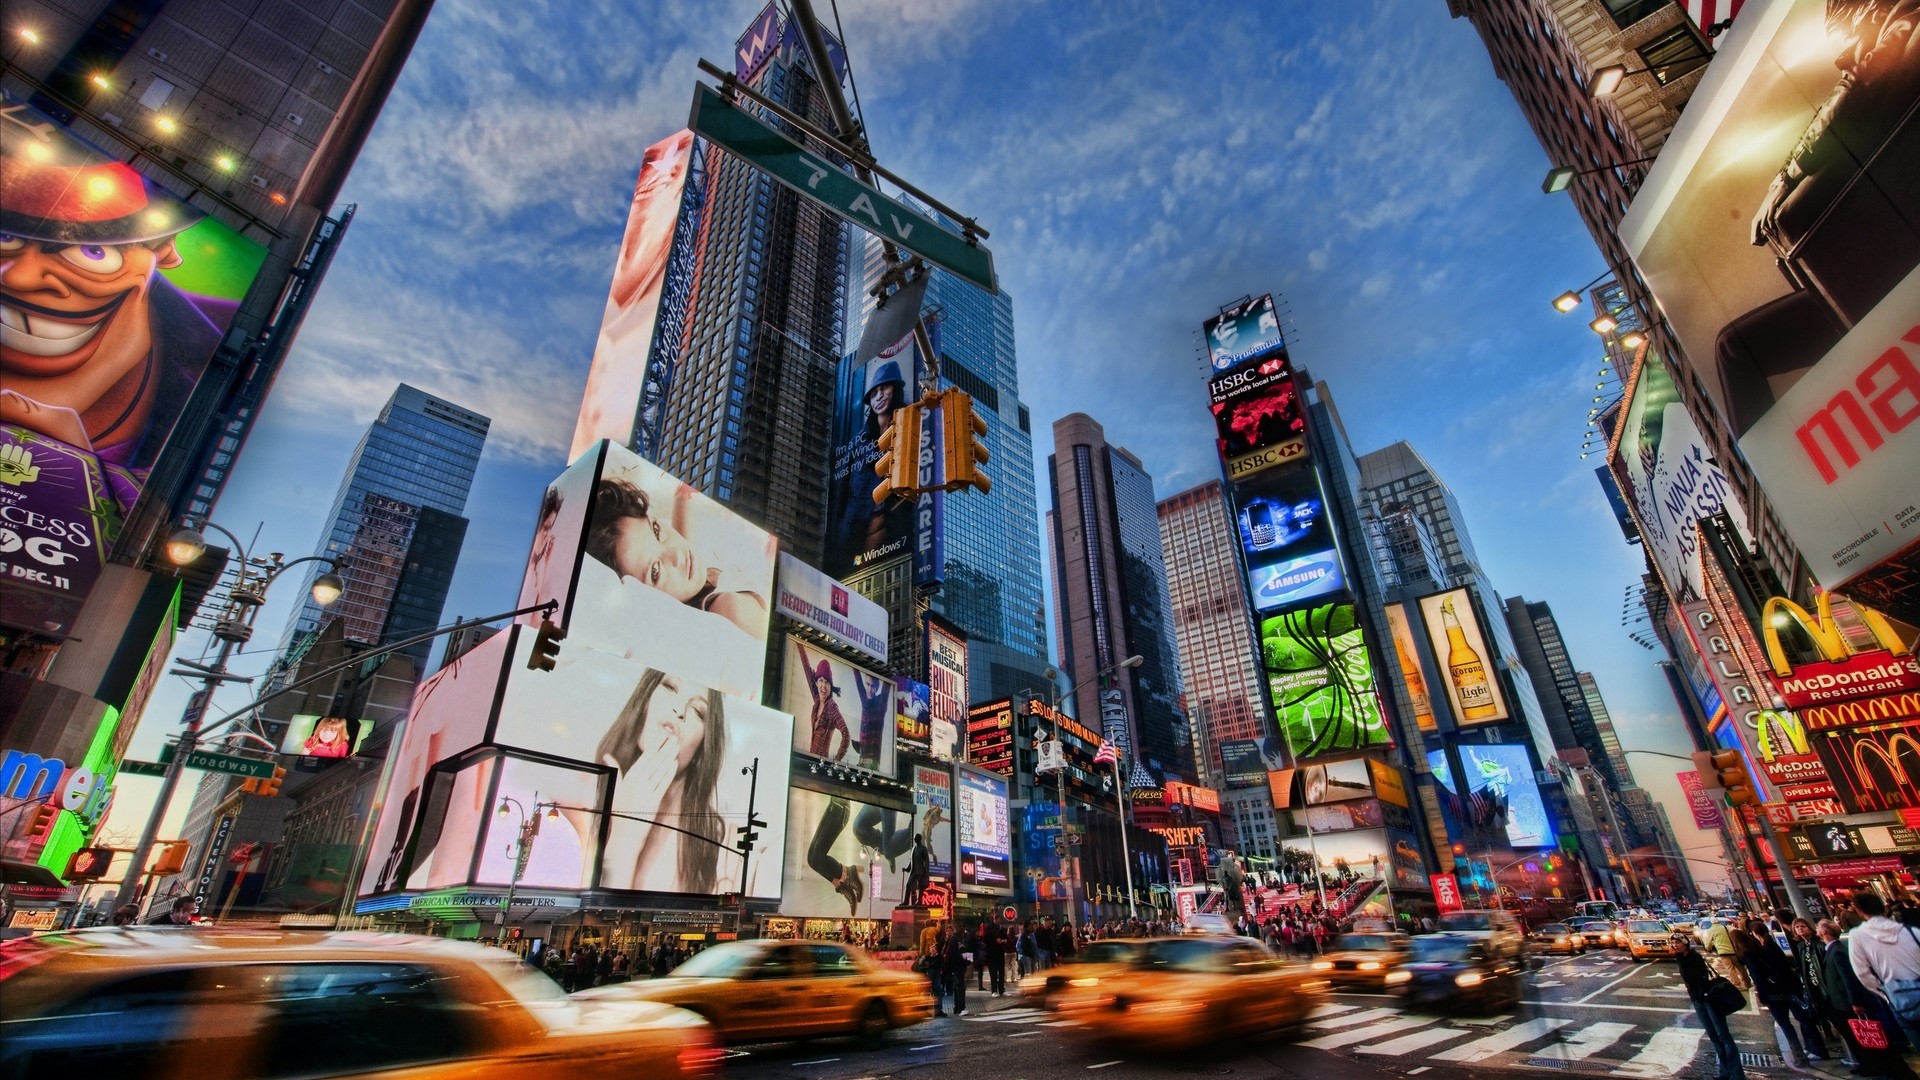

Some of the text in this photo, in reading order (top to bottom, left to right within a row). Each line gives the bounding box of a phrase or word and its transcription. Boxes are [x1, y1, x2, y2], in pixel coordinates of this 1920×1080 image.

[799, 156, 828, 190] 7
[1231, 336, 1281, 362] Prudential
[1211, 368, 1256, 395] HSBC
[1213, 370, 1288, 403] The world's local bank
[855, 431, 867, 446] PC
[835, 438, 880, 469] and Windo
[1230, 449, 1277, 475] HSBC
[834, 467, 849, 480] was
[851, 458, 865, 472] my
[918, 430, 934, 552] SQUARE
[1663, 454, 1702, 524] NINJA
[1894, 505, 1916, 521] DATA
[863, 536, 907, 561] Windows 7
[1832, 528, 1879, 560] RECORDABLE
[918, 564, 932, 574] NYC
[1836, 552, 1860, 567] MEDIA
[11, 565, 52, 585] DEC.
[53, 575, 70, 590] 11
[1268, 568, 1326, 590] SAMSUNG
[781, 590, 886, 656] READY FOR HOLIDAY CHEER
[939, 643, 957, 660] BEST
[931, 650, 964, 676] MUSICAL
[1452, 665, 1482, 677] Corona
[932, 664, 954, 698] BILLY
[1270, 668, 1328, 686] display powered
[1274, 676, 1328, 693] by wind energy
[1782, 660, 1920, 695] McDonald's
[1460, 685, 1488, 699] Light
[1810, 679, 1904, 700] Restaurant
[969, 700, 1010, 716] THOMSON REUTERS
[1100, 689, 1128, 752] SHEY'S
[137, 762, 146, 773] 7
[191, 755, 259, 775] roadway
[1769, 762, 1821, 774] McDon
[1785, 769, 1826, 779] Restaur
[919, 768, 950, 789] HEIGHTS
[1131, 788, 1163, 799] Reese's
[1785, 789, 1812, 797] OPEN
[193, 820, 229, 914] SCIENTOLOG
[962, 862, 974, 876] CNN
[452, 894, 487, 906] EAGLE
[1436, 876, 1454, 905] tkts
